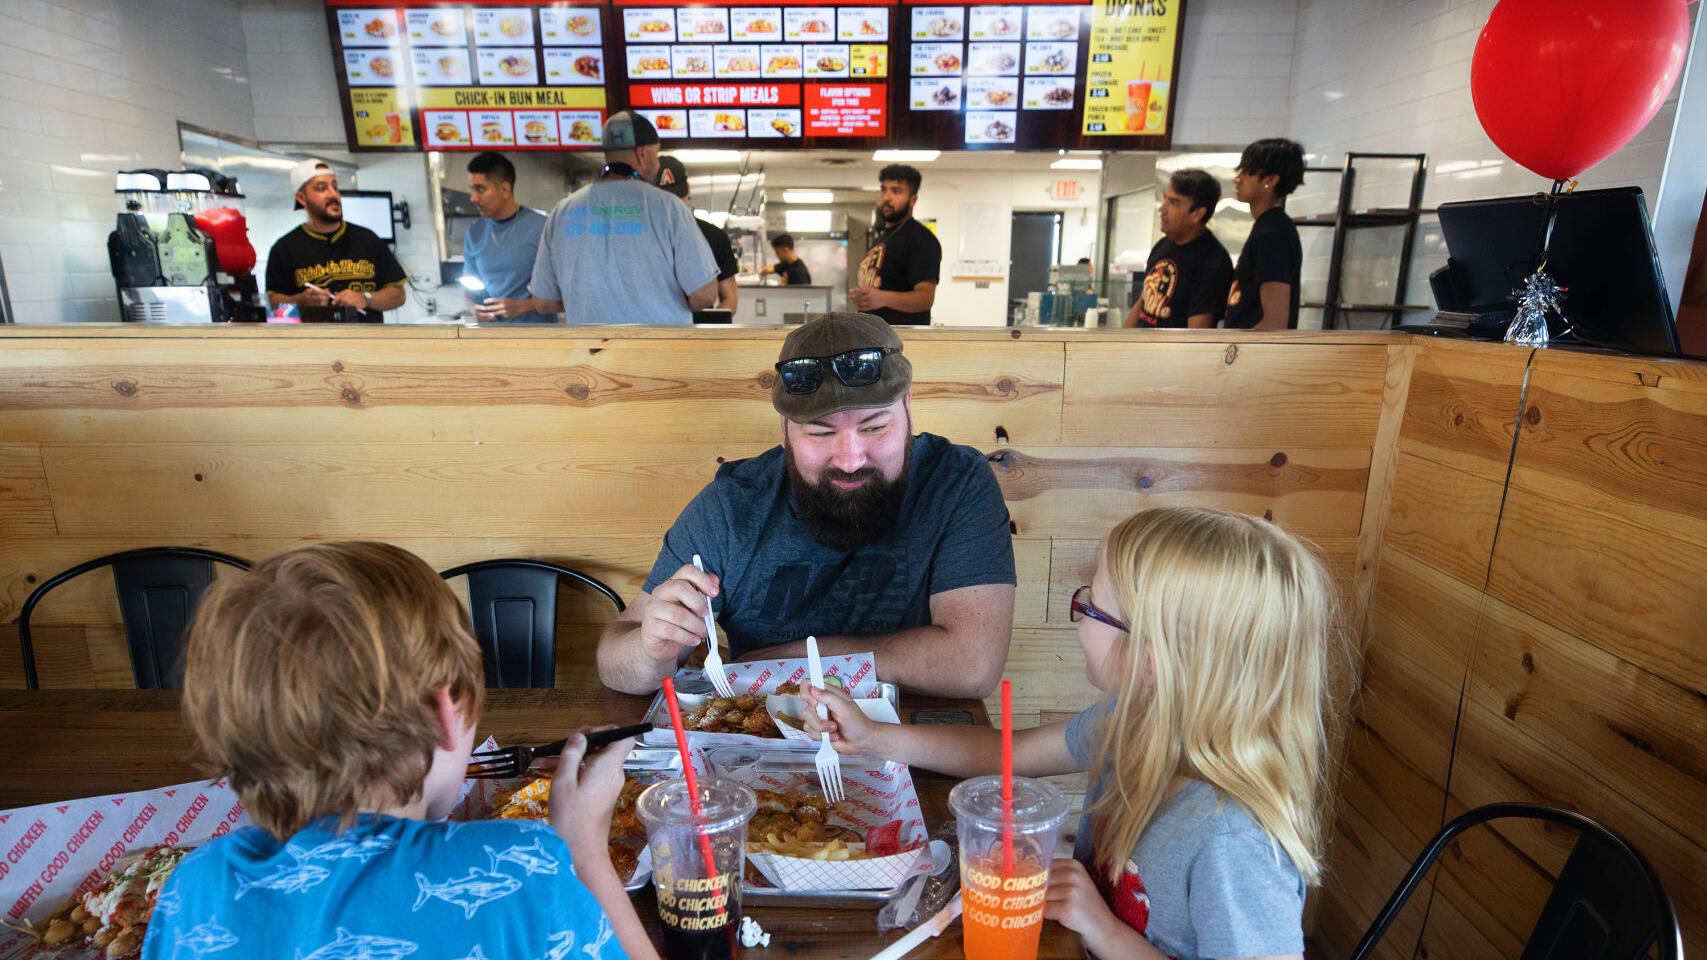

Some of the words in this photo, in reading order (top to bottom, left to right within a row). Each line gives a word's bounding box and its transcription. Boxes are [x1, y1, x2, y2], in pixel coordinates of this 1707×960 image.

[455, 91, 506, 106] CHICK-IN
[509, 91, 533, 106] BUN
[536, 91, 567, 106] MEAL
[651, 87, 682, 104] WING
[685, 87, 701, 103] OR
[703, 87, 738, 103] STRIP
[740, 86, 779, 103] MEALS
[1056, 181, 1078, 199] EXIT
[175, 793, 208, 834] CHICKEN
[227, 800, 247, 824] CHIC
[7, 819, 47, 864] CHICKEN
[98, 841, 126, 872] GOOD
[122, 802, 158, 844] CHICKEN
[7, 880, 44, 919] WAFFLY
[41, 851, 69, 883] GOOD
[66, 810, 104, 853] CHICKEN
[677, 873, 729, 892] CHICKEN
[968, 868, 1001, 889] GOOD
[679, 893, 729, 911] CHICKEN
[968, 888, 1000, 908] GOOD
[660, 909, 678, 927] OOD
[680, 911, 729, 931] CHICKEN
[968, 907, 1000, 927] GOOD
